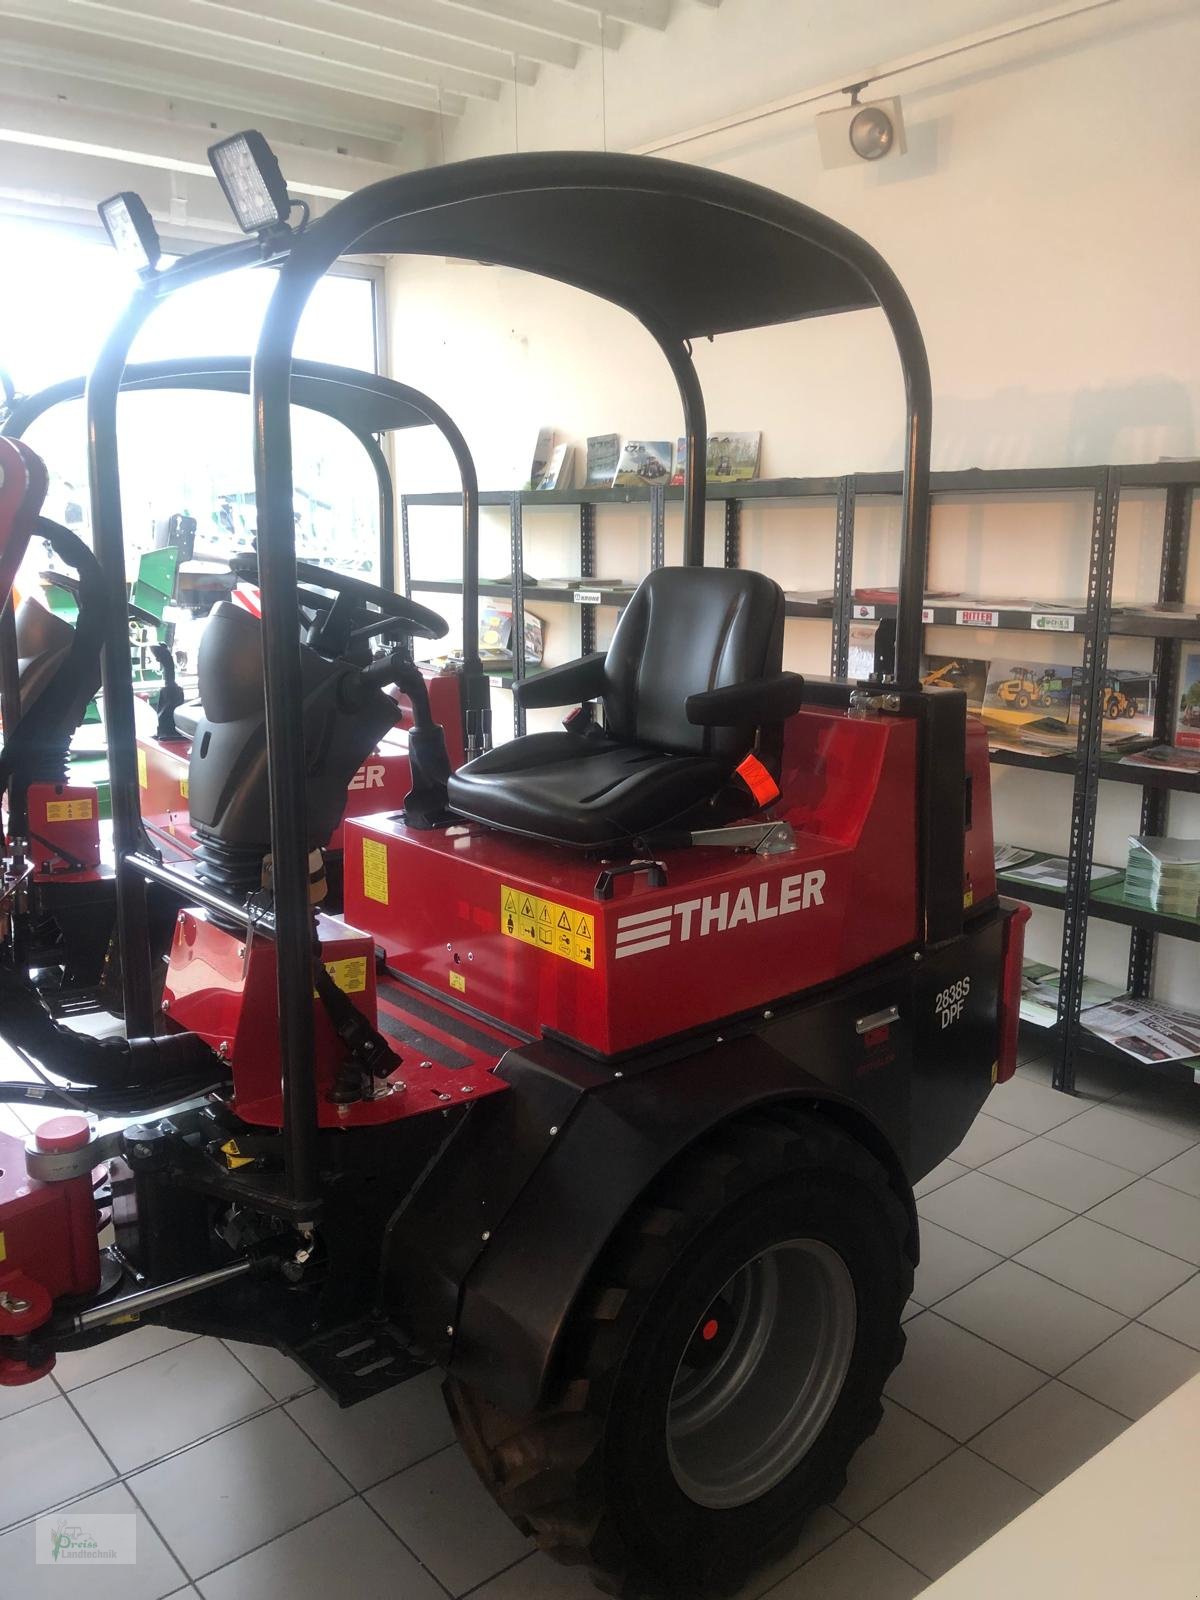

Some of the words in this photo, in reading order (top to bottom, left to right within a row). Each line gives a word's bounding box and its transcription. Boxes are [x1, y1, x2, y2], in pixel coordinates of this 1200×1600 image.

[962, 611, 993, 621] RITTER
[674, 869, 826, 942] THALER
[934, 976, 971, 1013] 2838S
[941, 998, 965, 1030] DPF
